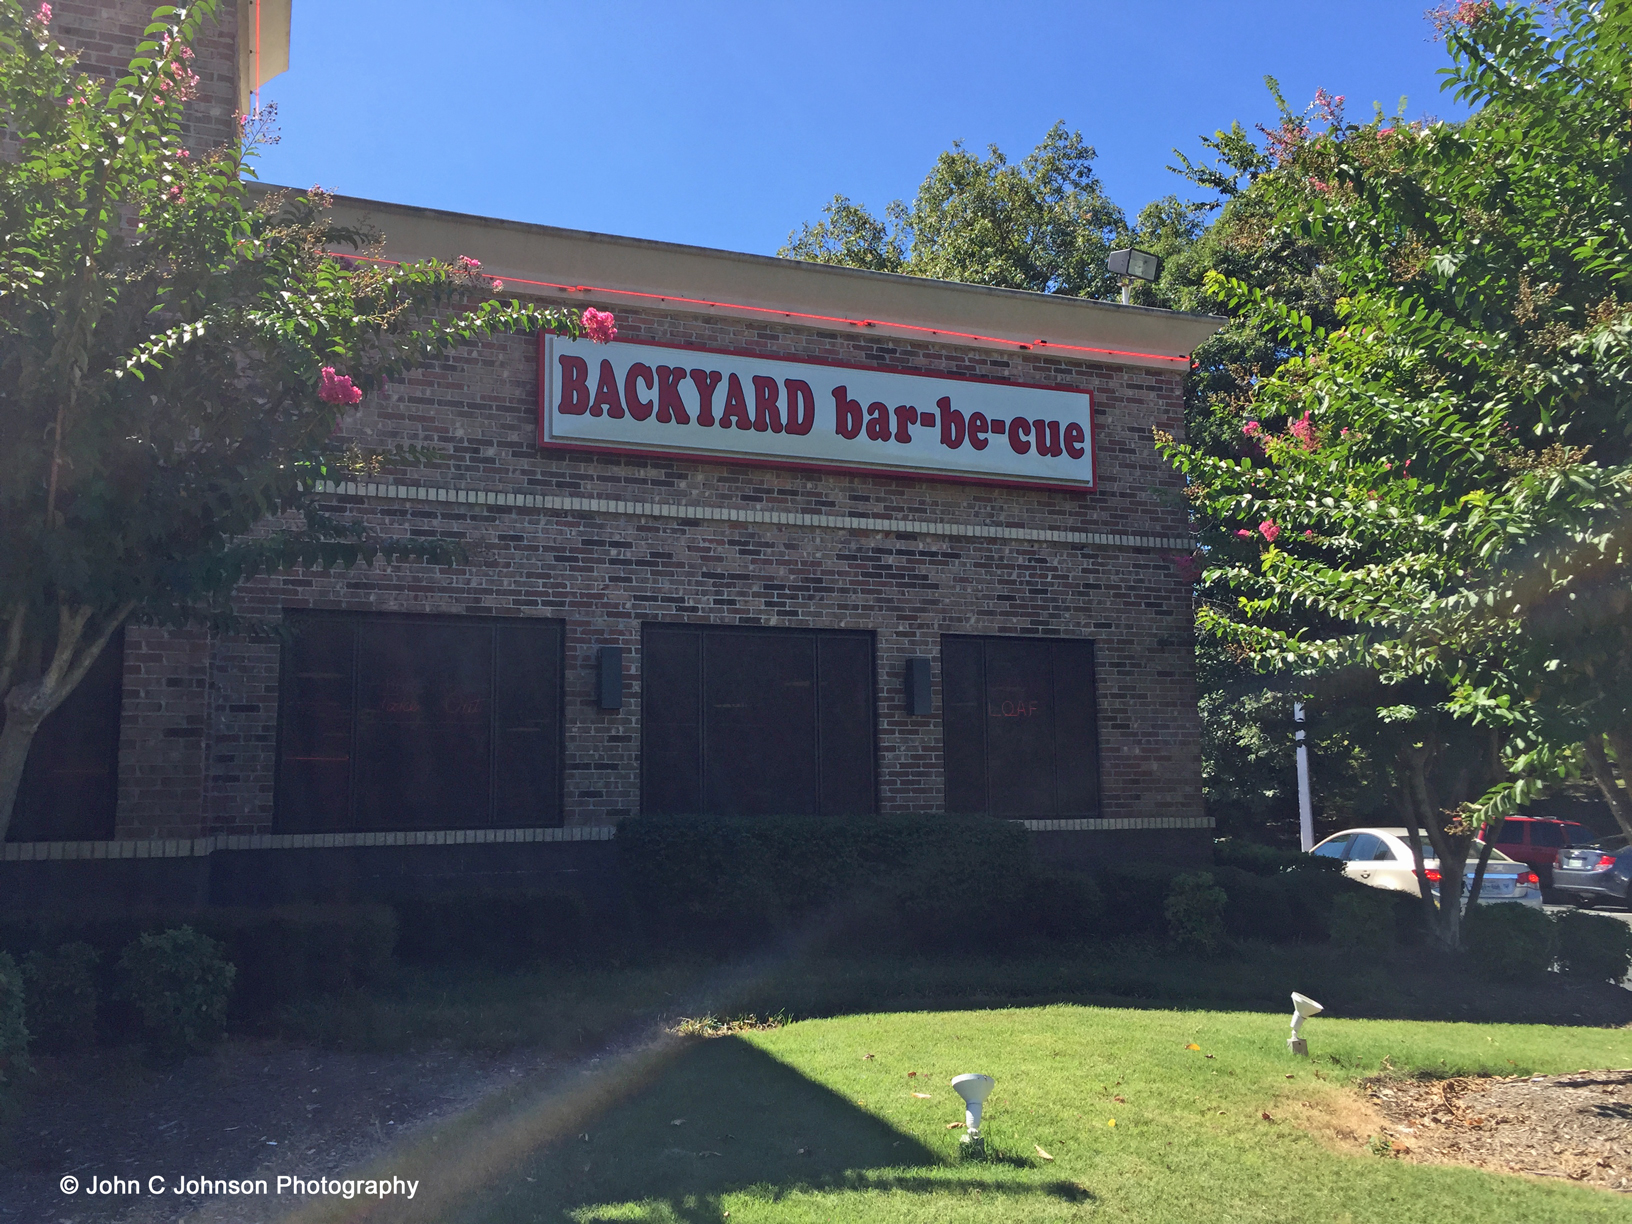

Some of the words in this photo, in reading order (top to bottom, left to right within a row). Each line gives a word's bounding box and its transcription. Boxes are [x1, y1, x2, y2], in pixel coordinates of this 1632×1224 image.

[557, 353, 815, 437] BACKYARD
[832, 385, 1086, 460] bar-be-cue
[445, 694, 485, 714] Out
